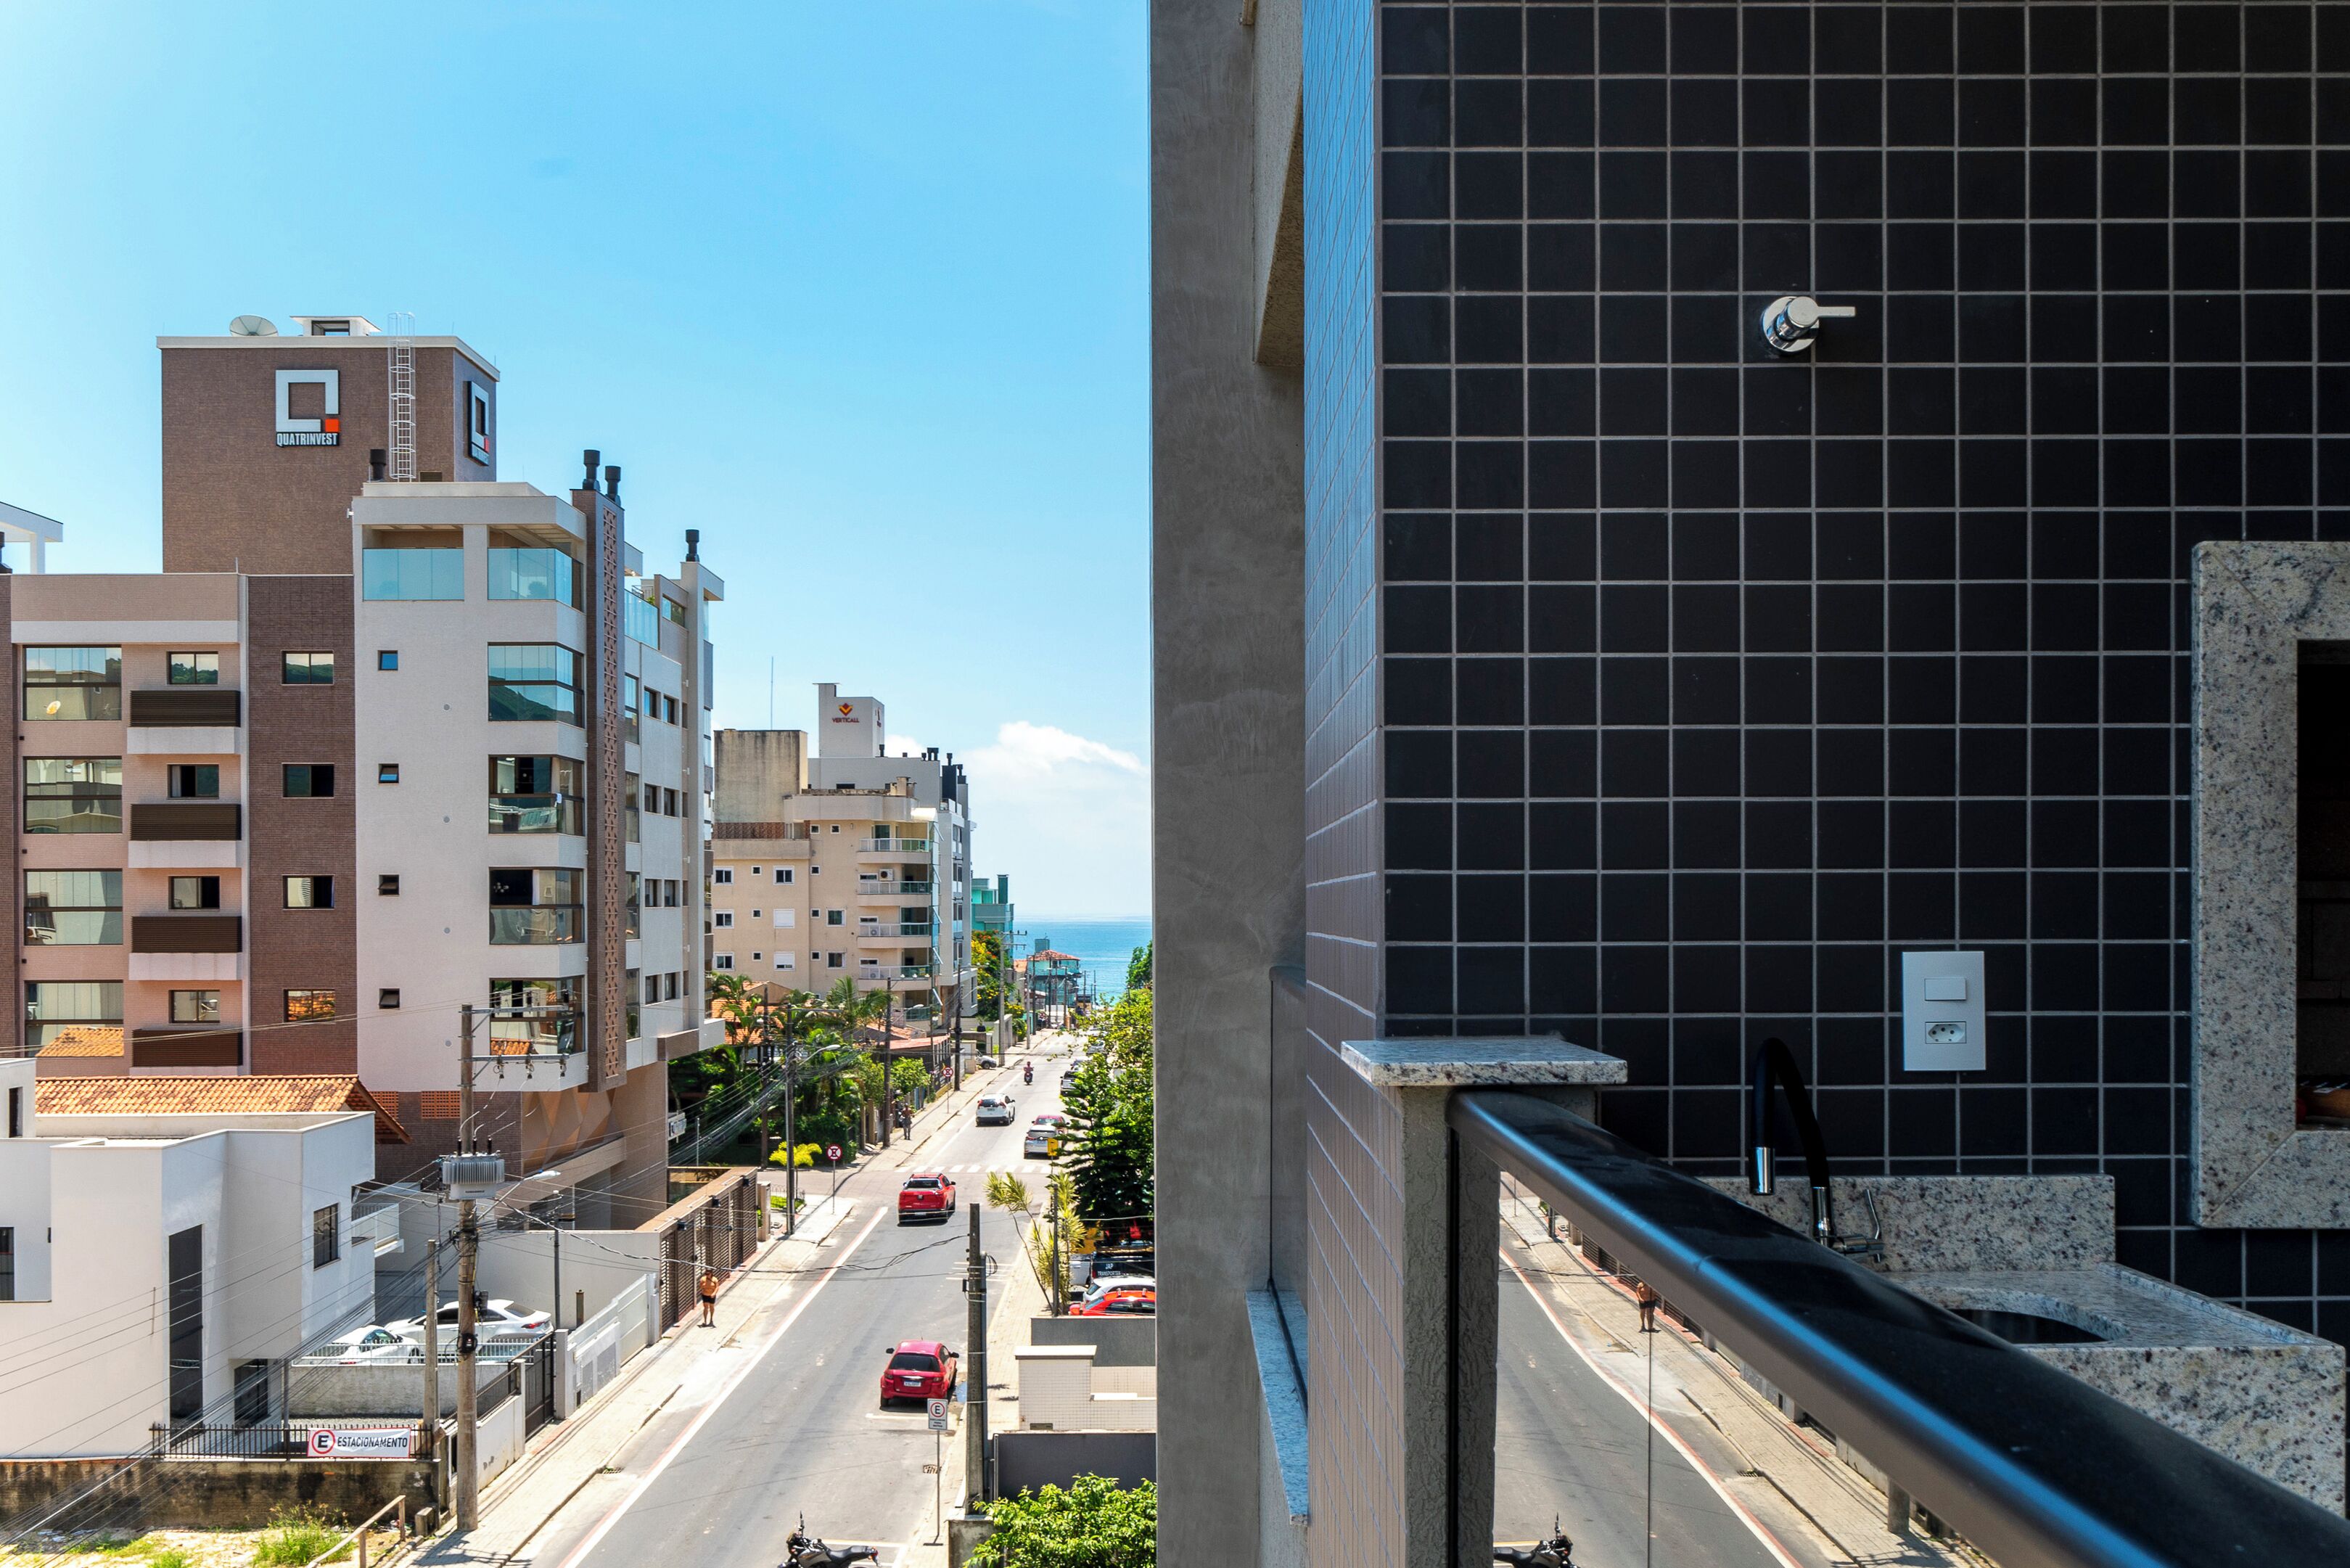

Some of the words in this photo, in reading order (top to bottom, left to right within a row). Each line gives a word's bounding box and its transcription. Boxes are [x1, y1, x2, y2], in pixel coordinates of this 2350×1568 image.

[276, 433, 337, 446] QUATRINVEST
[934, 1405, 941, 1414] E
[318, 1434, 329, 1448] E
[337, 1436, 408, 1448] ESTACIONAMENTO
